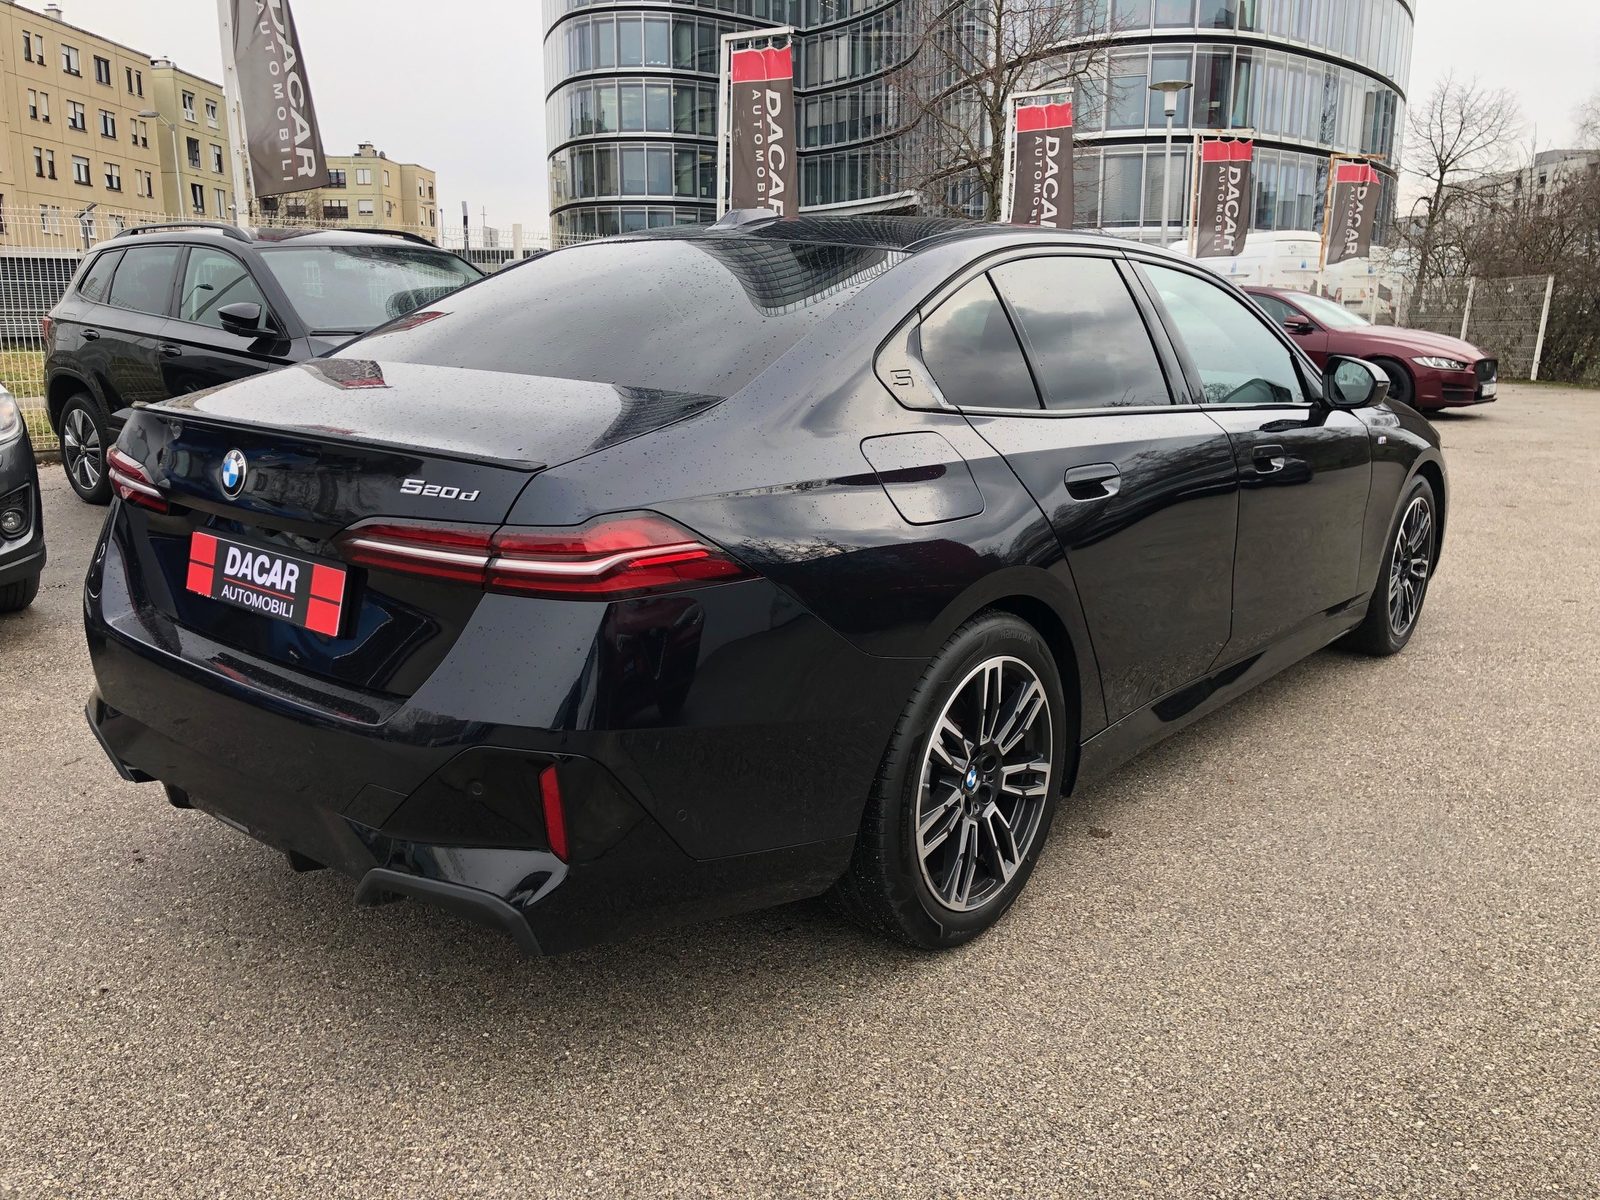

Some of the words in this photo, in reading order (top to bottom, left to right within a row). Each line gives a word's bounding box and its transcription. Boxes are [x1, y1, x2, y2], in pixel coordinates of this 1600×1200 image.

[255, 1, 294, 181] AUTOMOBILI
[1040, 135, 1060, 228] DACA
[1213, 166, 1226, 251] AUTOMOBILI
[399, 478, 480, 502] 520d
[221, 584, 294, 618] AUTOMOBILI
[223, 546, 300, 593] DACAR
